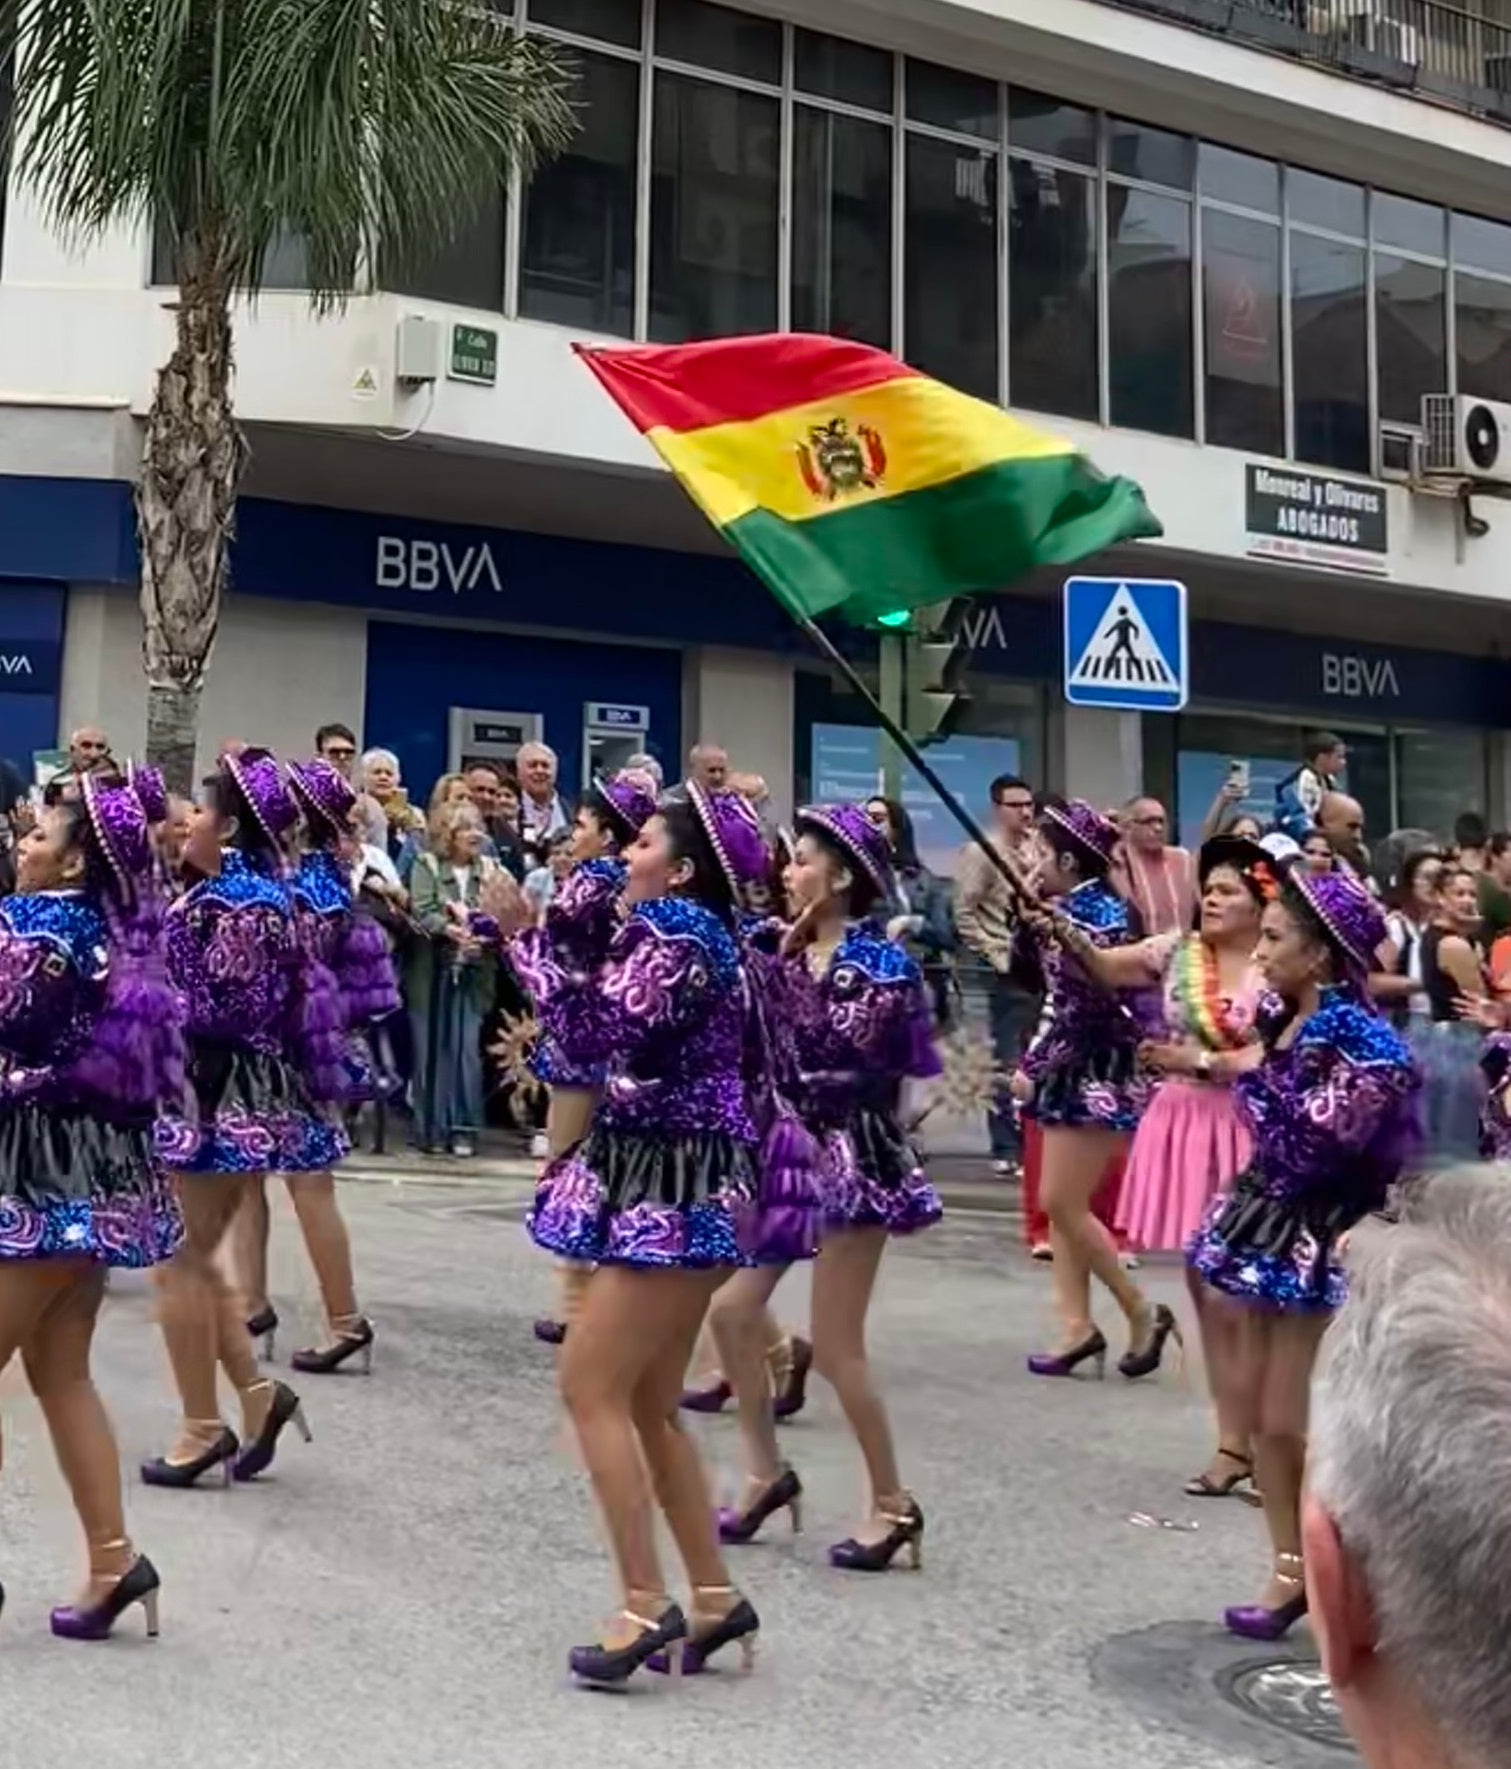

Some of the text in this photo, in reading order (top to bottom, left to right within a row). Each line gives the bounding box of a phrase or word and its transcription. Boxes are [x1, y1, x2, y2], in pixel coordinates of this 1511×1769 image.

[1255, 468, 1379, 514] Monreal y Olivares
[1277, 506, 1359, 542] ABOGADOS
[377, 536, 502, 594] BBVA
[954, 606, 1007, 649] VA
[1322, 654, 1399, 697] BBVA
